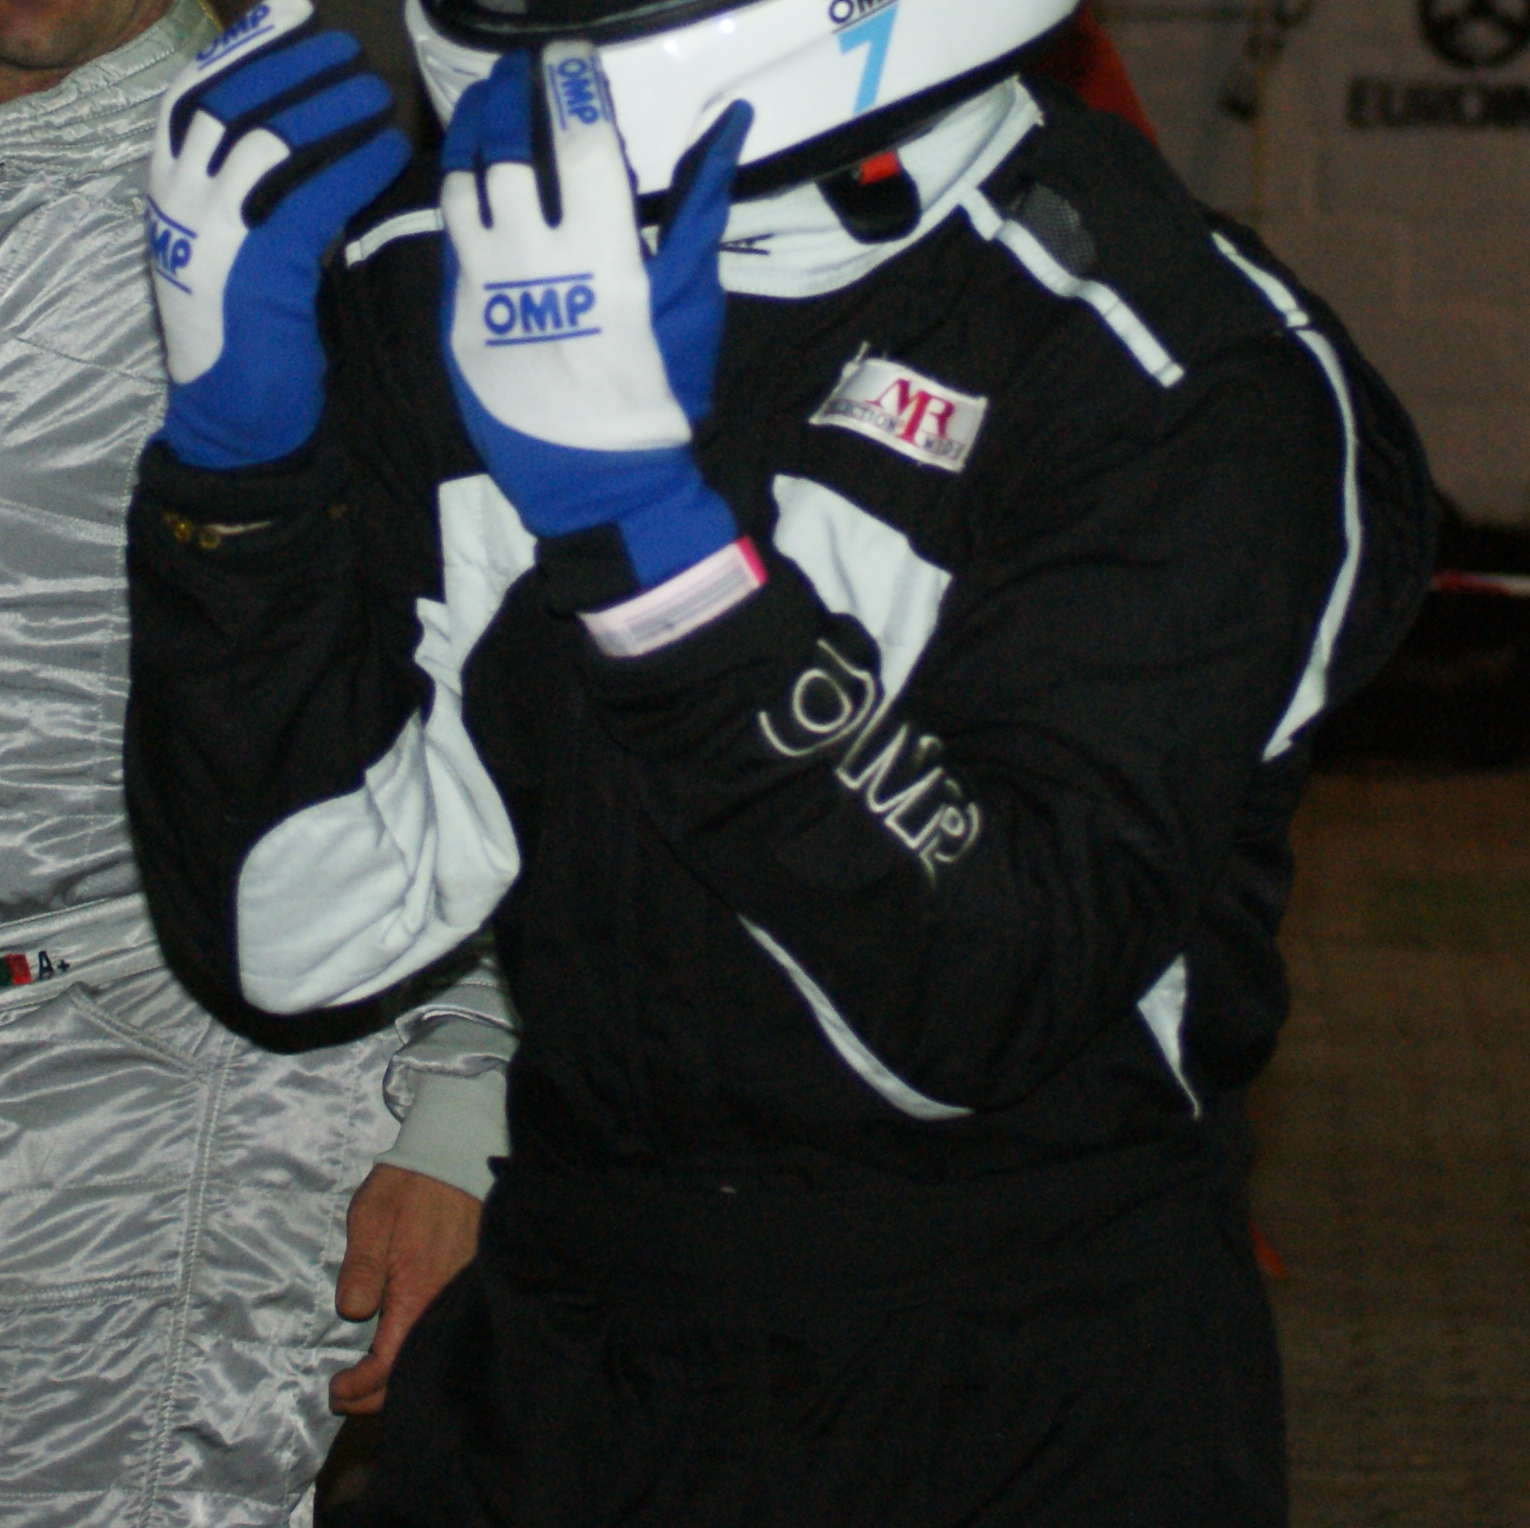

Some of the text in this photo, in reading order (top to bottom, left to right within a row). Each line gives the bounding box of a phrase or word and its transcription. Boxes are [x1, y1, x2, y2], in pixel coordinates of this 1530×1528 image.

[195, 3, 271, 62] OMP
[557, 58, 599, 125] OMP
[483, 284, 596, 335] OMP
